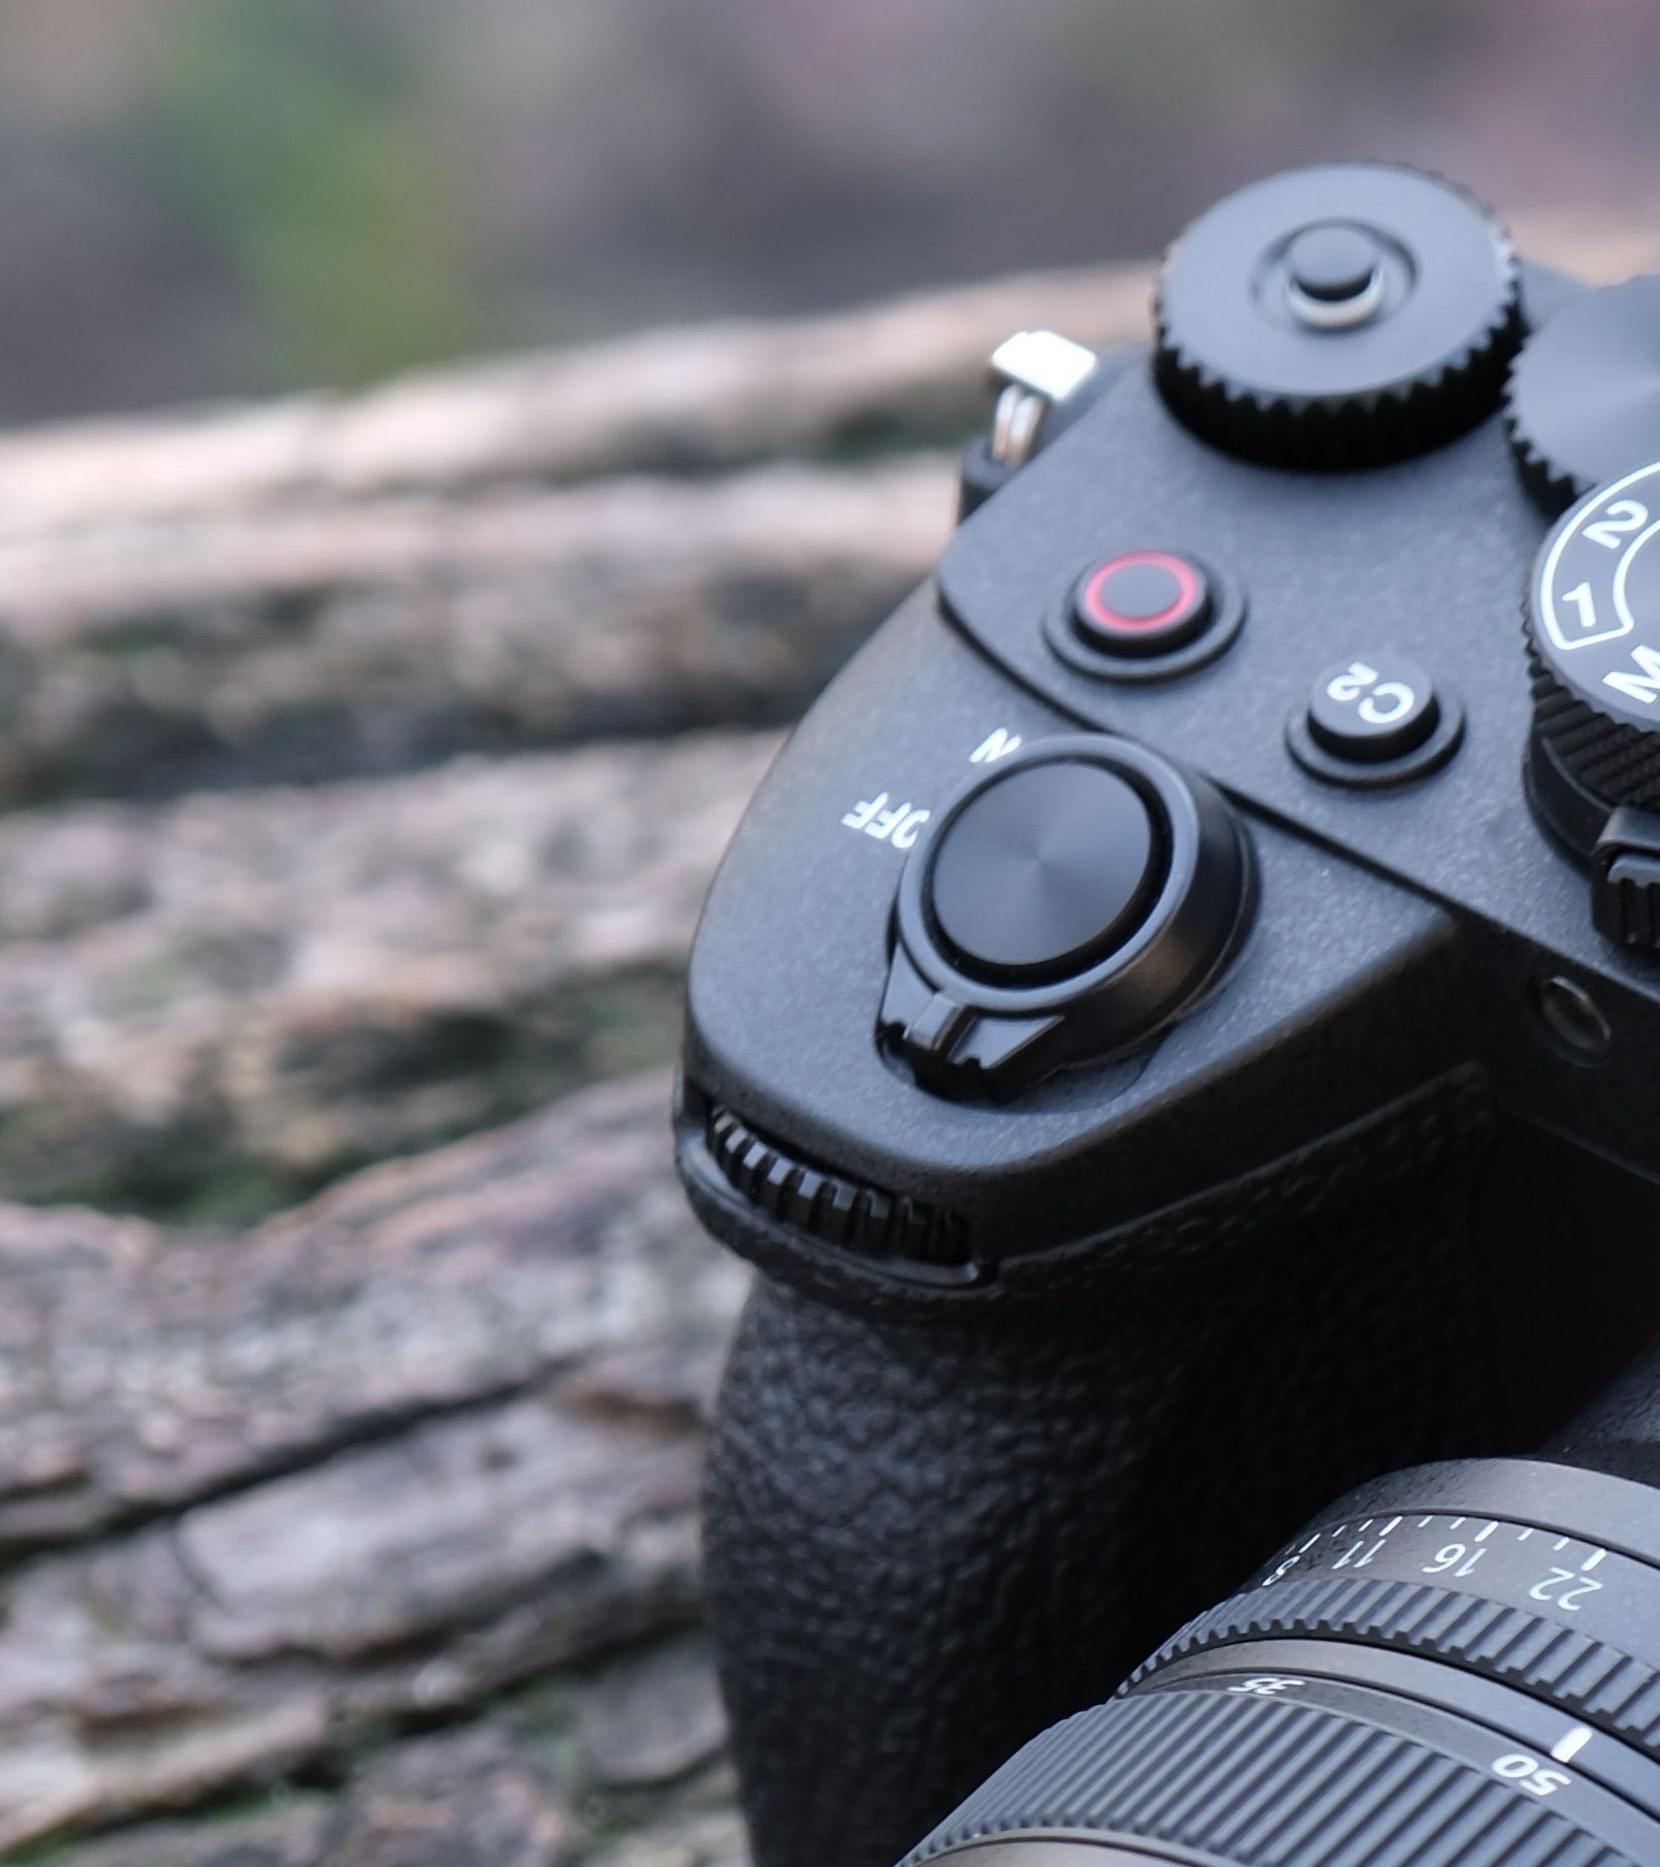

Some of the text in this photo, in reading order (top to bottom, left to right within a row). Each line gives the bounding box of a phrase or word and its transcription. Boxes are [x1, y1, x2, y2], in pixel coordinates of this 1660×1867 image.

[1582, 500, 1648, 550] 2
[1562, 582, 1596, 627] 1
[1328, 662, 1414, 724] C2
[841, 791, 930, 849] OFF
[1332, 1540, 1387, 1570] 11
[1422, 1543, 1488, 1577] 16
[1529, 1566, 1603, 1611] 22
[1492, 1753, 1572, 1797] 50
